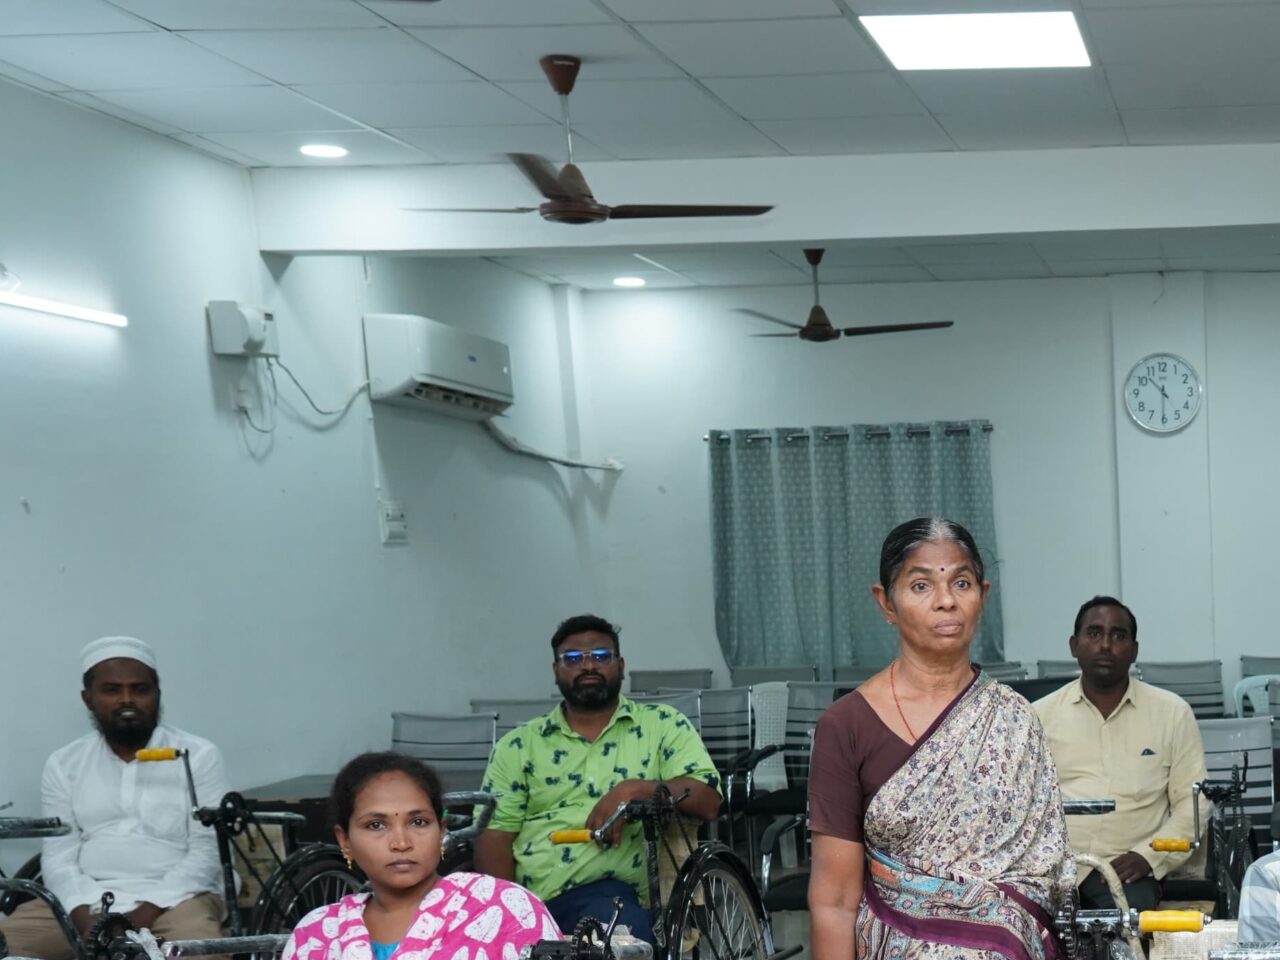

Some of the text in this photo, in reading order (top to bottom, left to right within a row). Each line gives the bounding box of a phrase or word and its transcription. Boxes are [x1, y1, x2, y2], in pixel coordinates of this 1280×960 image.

[1146, 366, 1155, 377] 11
[1157, 361, 1168, 373] 12
[1137, 375, 1148, 387] 10
[1182, 373, 1189, 385] 2
[1133, 388, 1140, 399] 9
[1187, 386, 1194, 397] 3
[1138, 401, 1145, 412] 8
[1182, 400, 1190, 410] 4
[1148, 409, 1155, 421] 7
[1161, 414, 1168, 425] 6
[1174, 409, 1181, 421] 5
